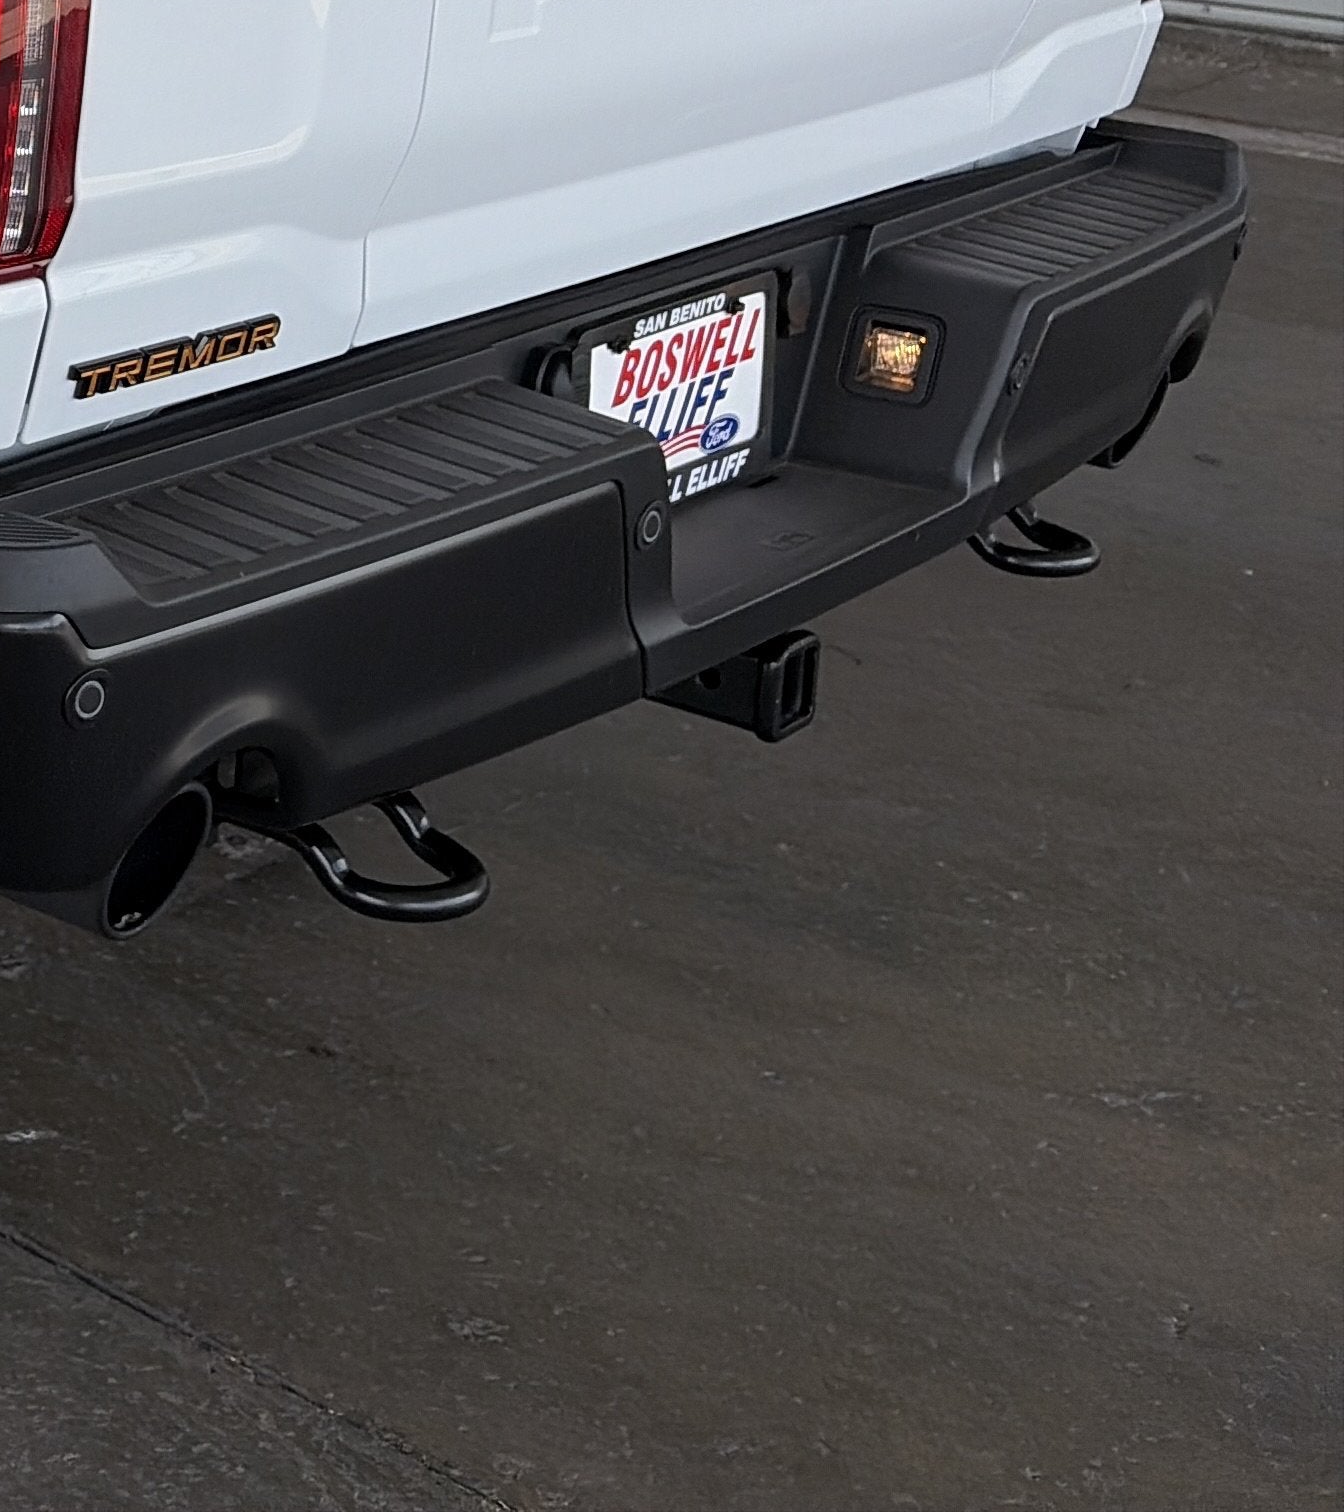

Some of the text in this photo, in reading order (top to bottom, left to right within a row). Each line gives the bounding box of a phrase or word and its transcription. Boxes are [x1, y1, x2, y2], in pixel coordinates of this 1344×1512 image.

[633, 292, 727, 339] SAN BENITO
[69, 315, 281, 399] TREMOR
[611, 307, 762, 409] BOSWELL
[704, 419, 735, 449] Ford
[685, 448, 751, 497] ELLIFF
